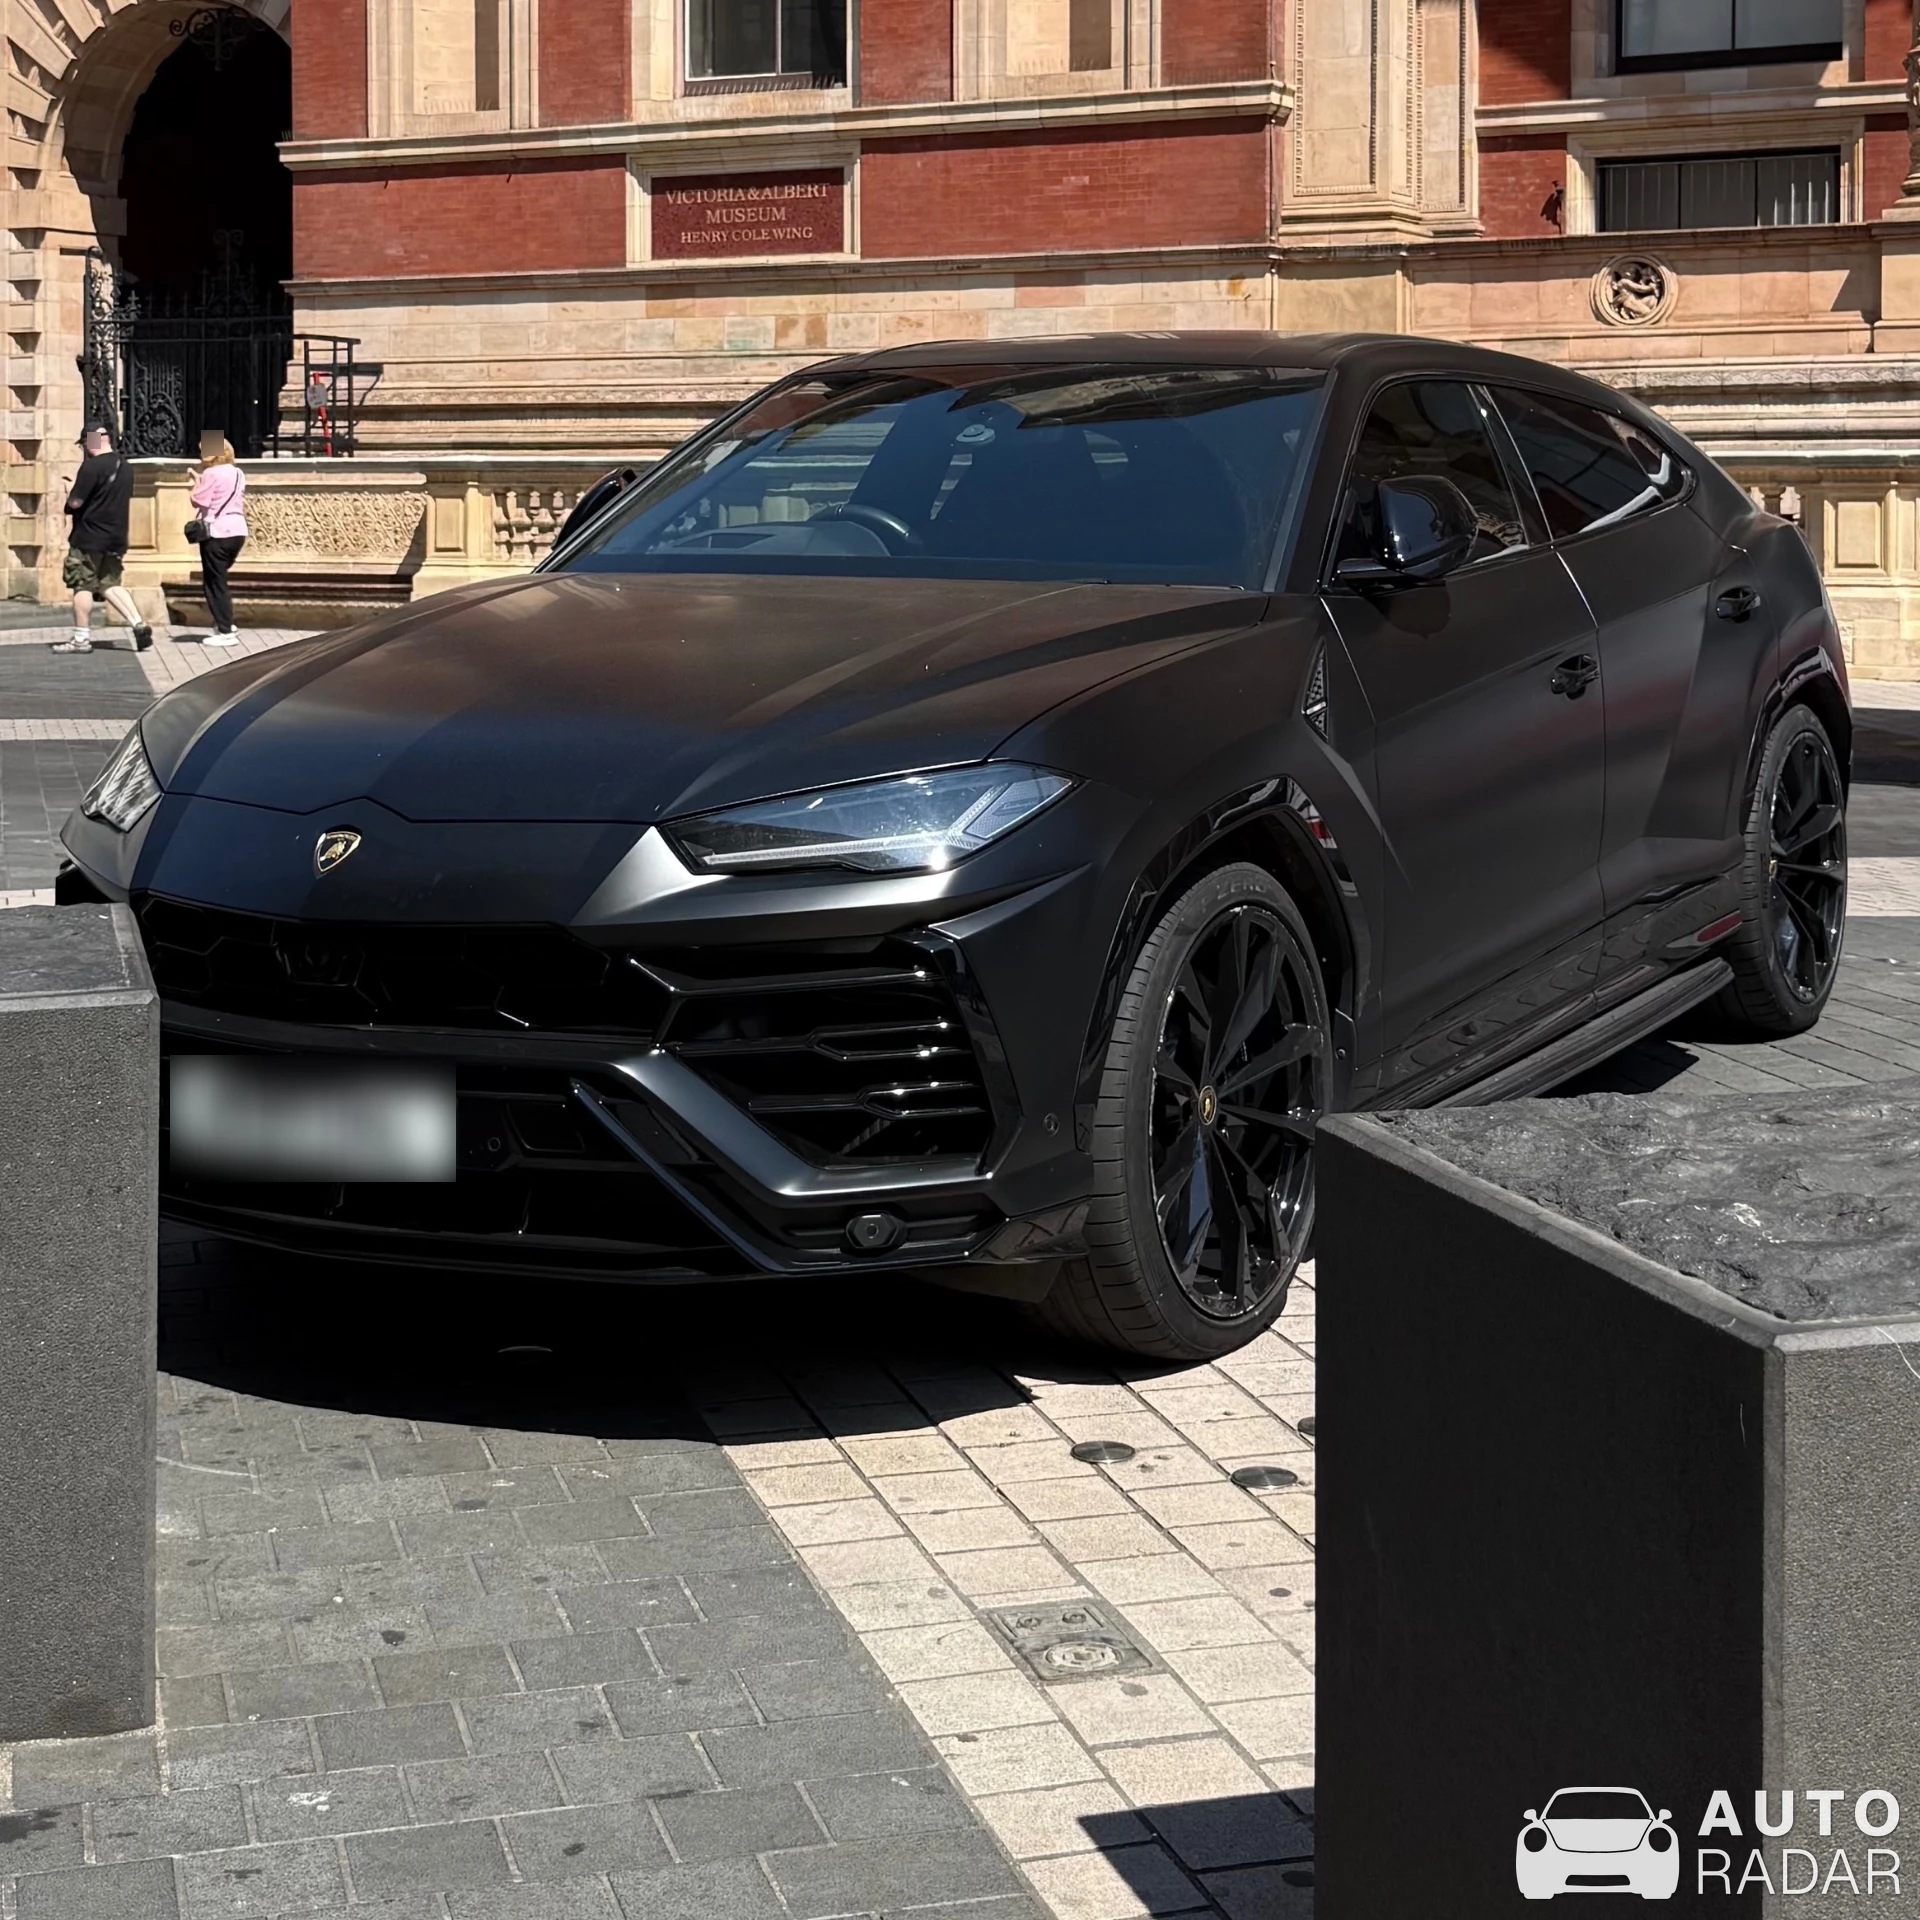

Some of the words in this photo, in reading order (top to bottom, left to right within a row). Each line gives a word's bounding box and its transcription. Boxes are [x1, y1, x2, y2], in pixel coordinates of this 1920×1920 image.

[705, 206, 787, 224] MUSEUM
[681, 230, 729, 243] HENRY
[732, 229, 770, 241] COLE
[772, 226, 813, 239] WING
